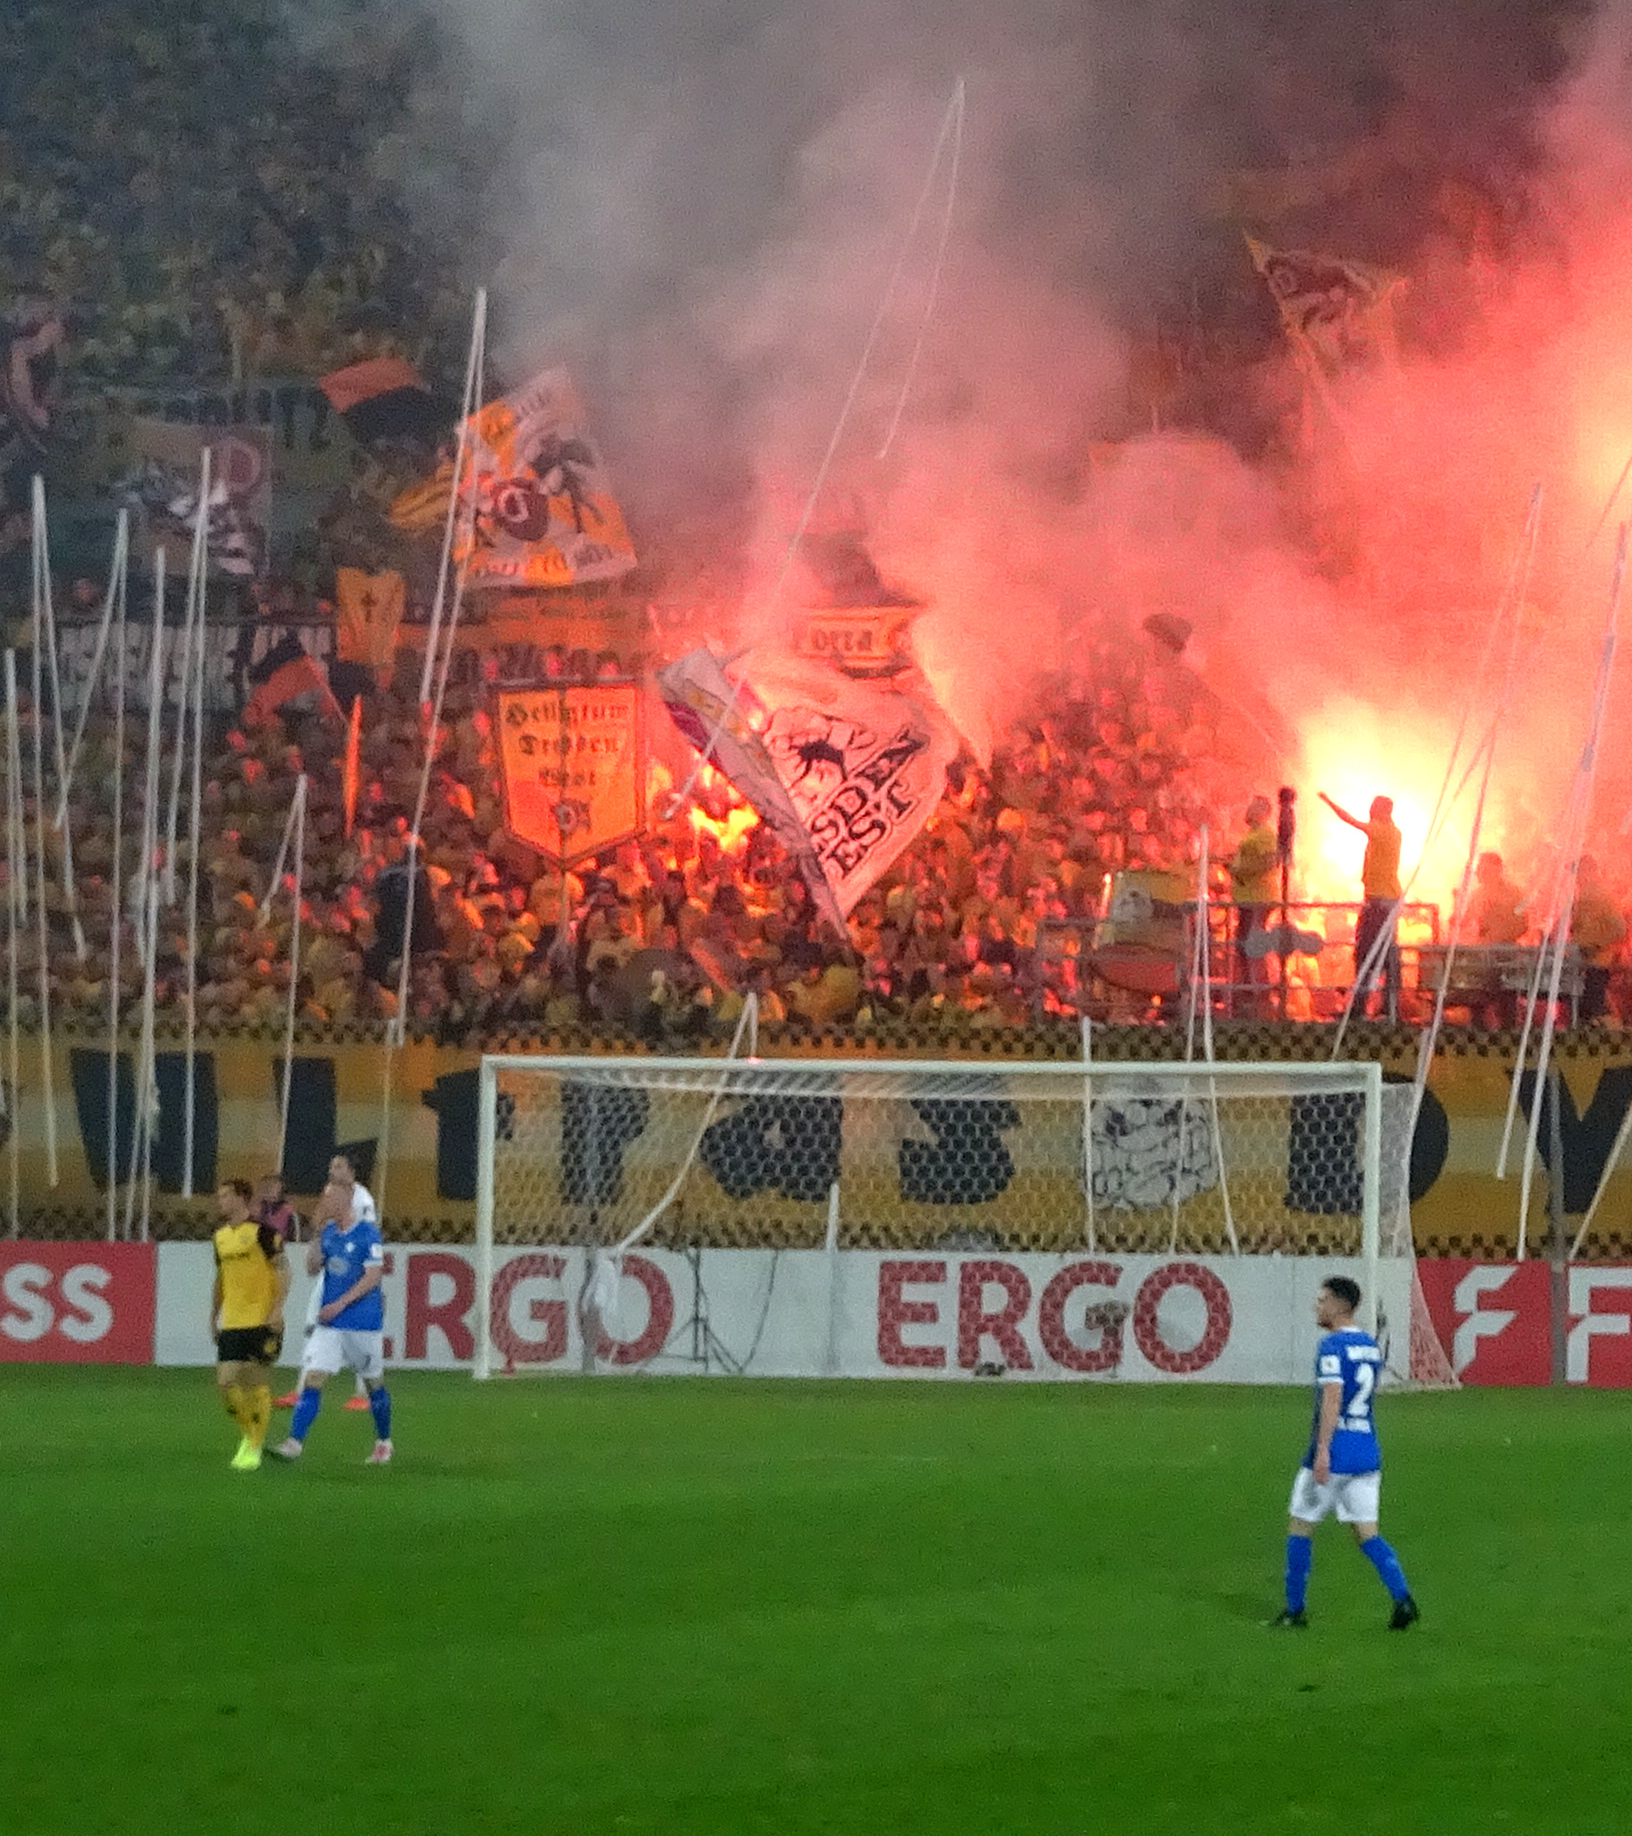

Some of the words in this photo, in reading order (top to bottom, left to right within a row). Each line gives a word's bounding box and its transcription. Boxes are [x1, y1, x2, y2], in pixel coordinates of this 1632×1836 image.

[380, 1254, 676, 1366] RGO
[877, 1261, 1234, 1375] ERGO
[1347, 1362, 1375, 1418] 2
